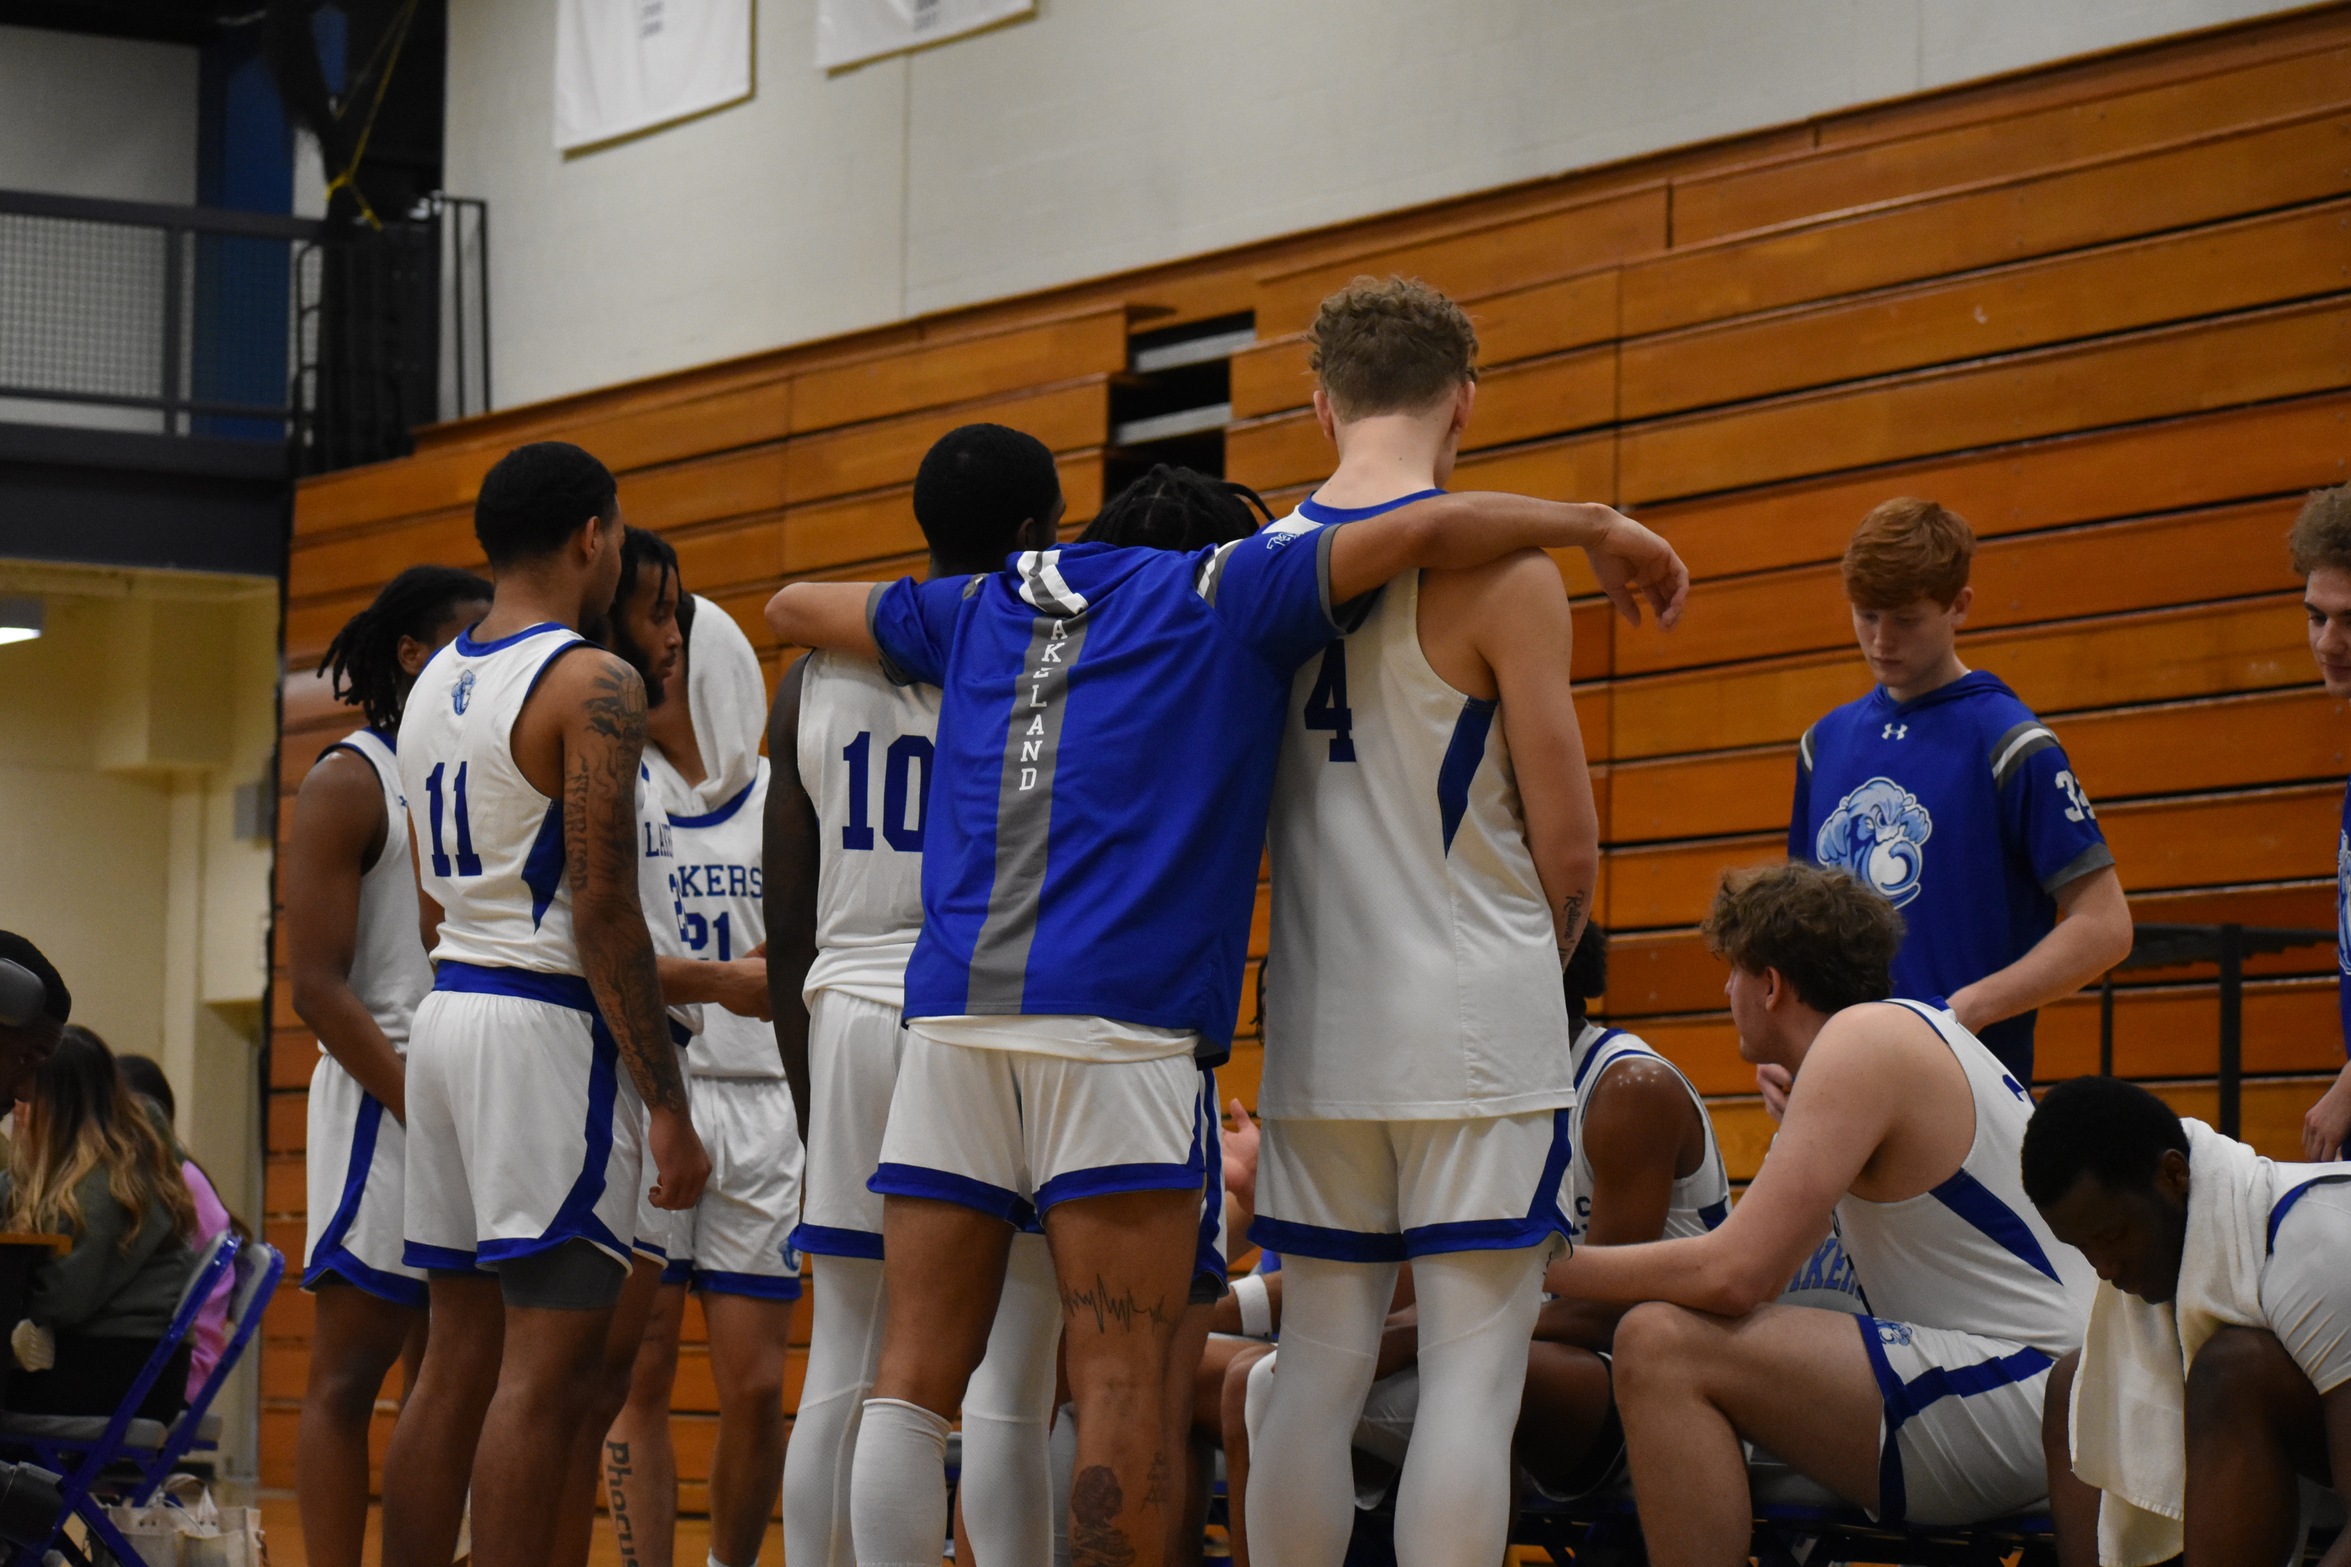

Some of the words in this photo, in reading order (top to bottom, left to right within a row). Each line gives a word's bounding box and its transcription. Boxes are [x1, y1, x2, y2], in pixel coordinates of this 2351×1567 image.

[1303, 638, 1357, 763] 4
[425, 760, 483, 877] 11
[842, 730, 936, 853] 10
